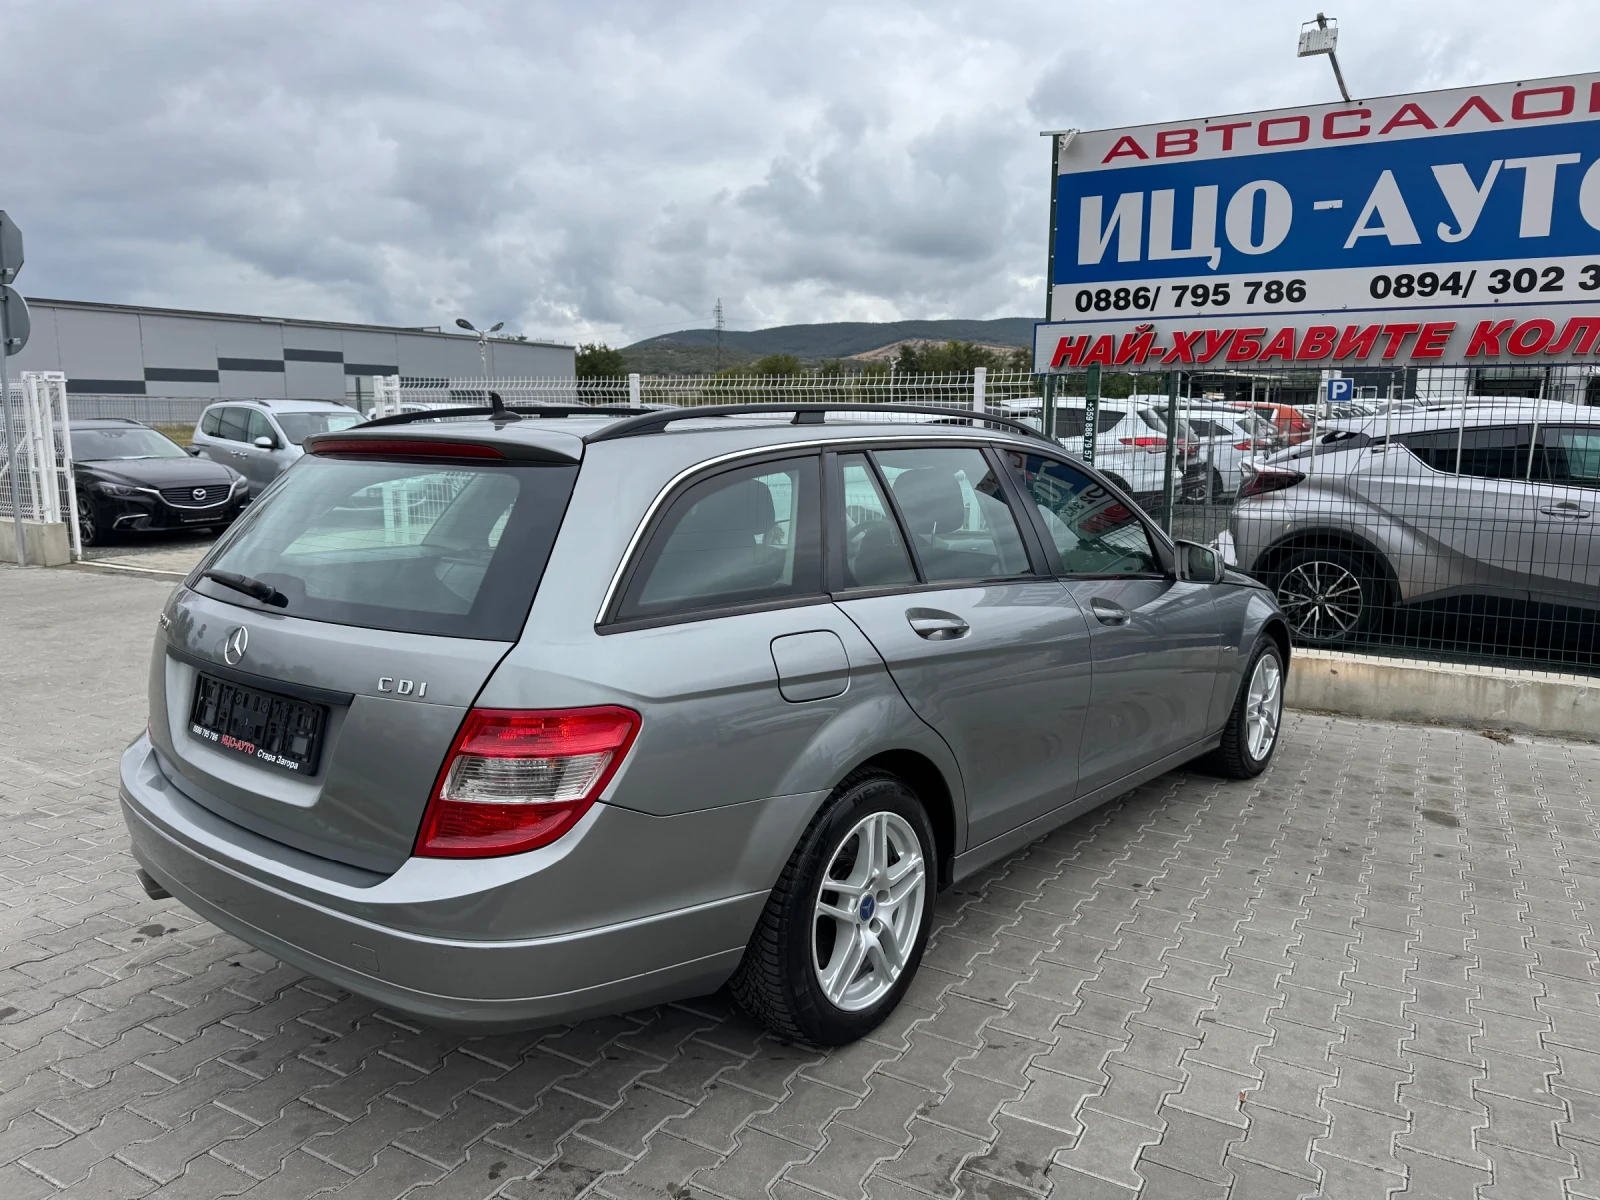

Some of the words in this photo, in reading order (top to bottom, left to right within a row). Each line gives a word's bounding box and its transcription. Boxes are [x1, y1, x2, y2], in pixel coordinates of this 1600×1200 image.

[1369, 269, 1477, 299] 0894/
[1487, 266, 1565, 294] 302
[1075, 286, 1161, 312] 0886/
[1171, 282, 1231, 308] 795
[1243, 279, 1307, 304] 786
[1050, 321, 1457, 368] НАЙ-ХУБАВИТЕ
[1464, 316, 1600, 358] КОЛ
[1331, 381, 1348, 399] P
[1085, 401, 1095, 421] +359
[1084, 422, 1094, 437] 886
[1084, 438, 1093, 448] 79
[1083, 450, 1093, 459] 57
[377, 676, 428, 698] CDI
[202, 728, 210, 738] 795
[209, 731, 219, 742] 786
[220, 733, 255, 755] ИЦО-АУТО
[256, 749, 276, 763] Стара
[276, 755, 299, 770] Загора
